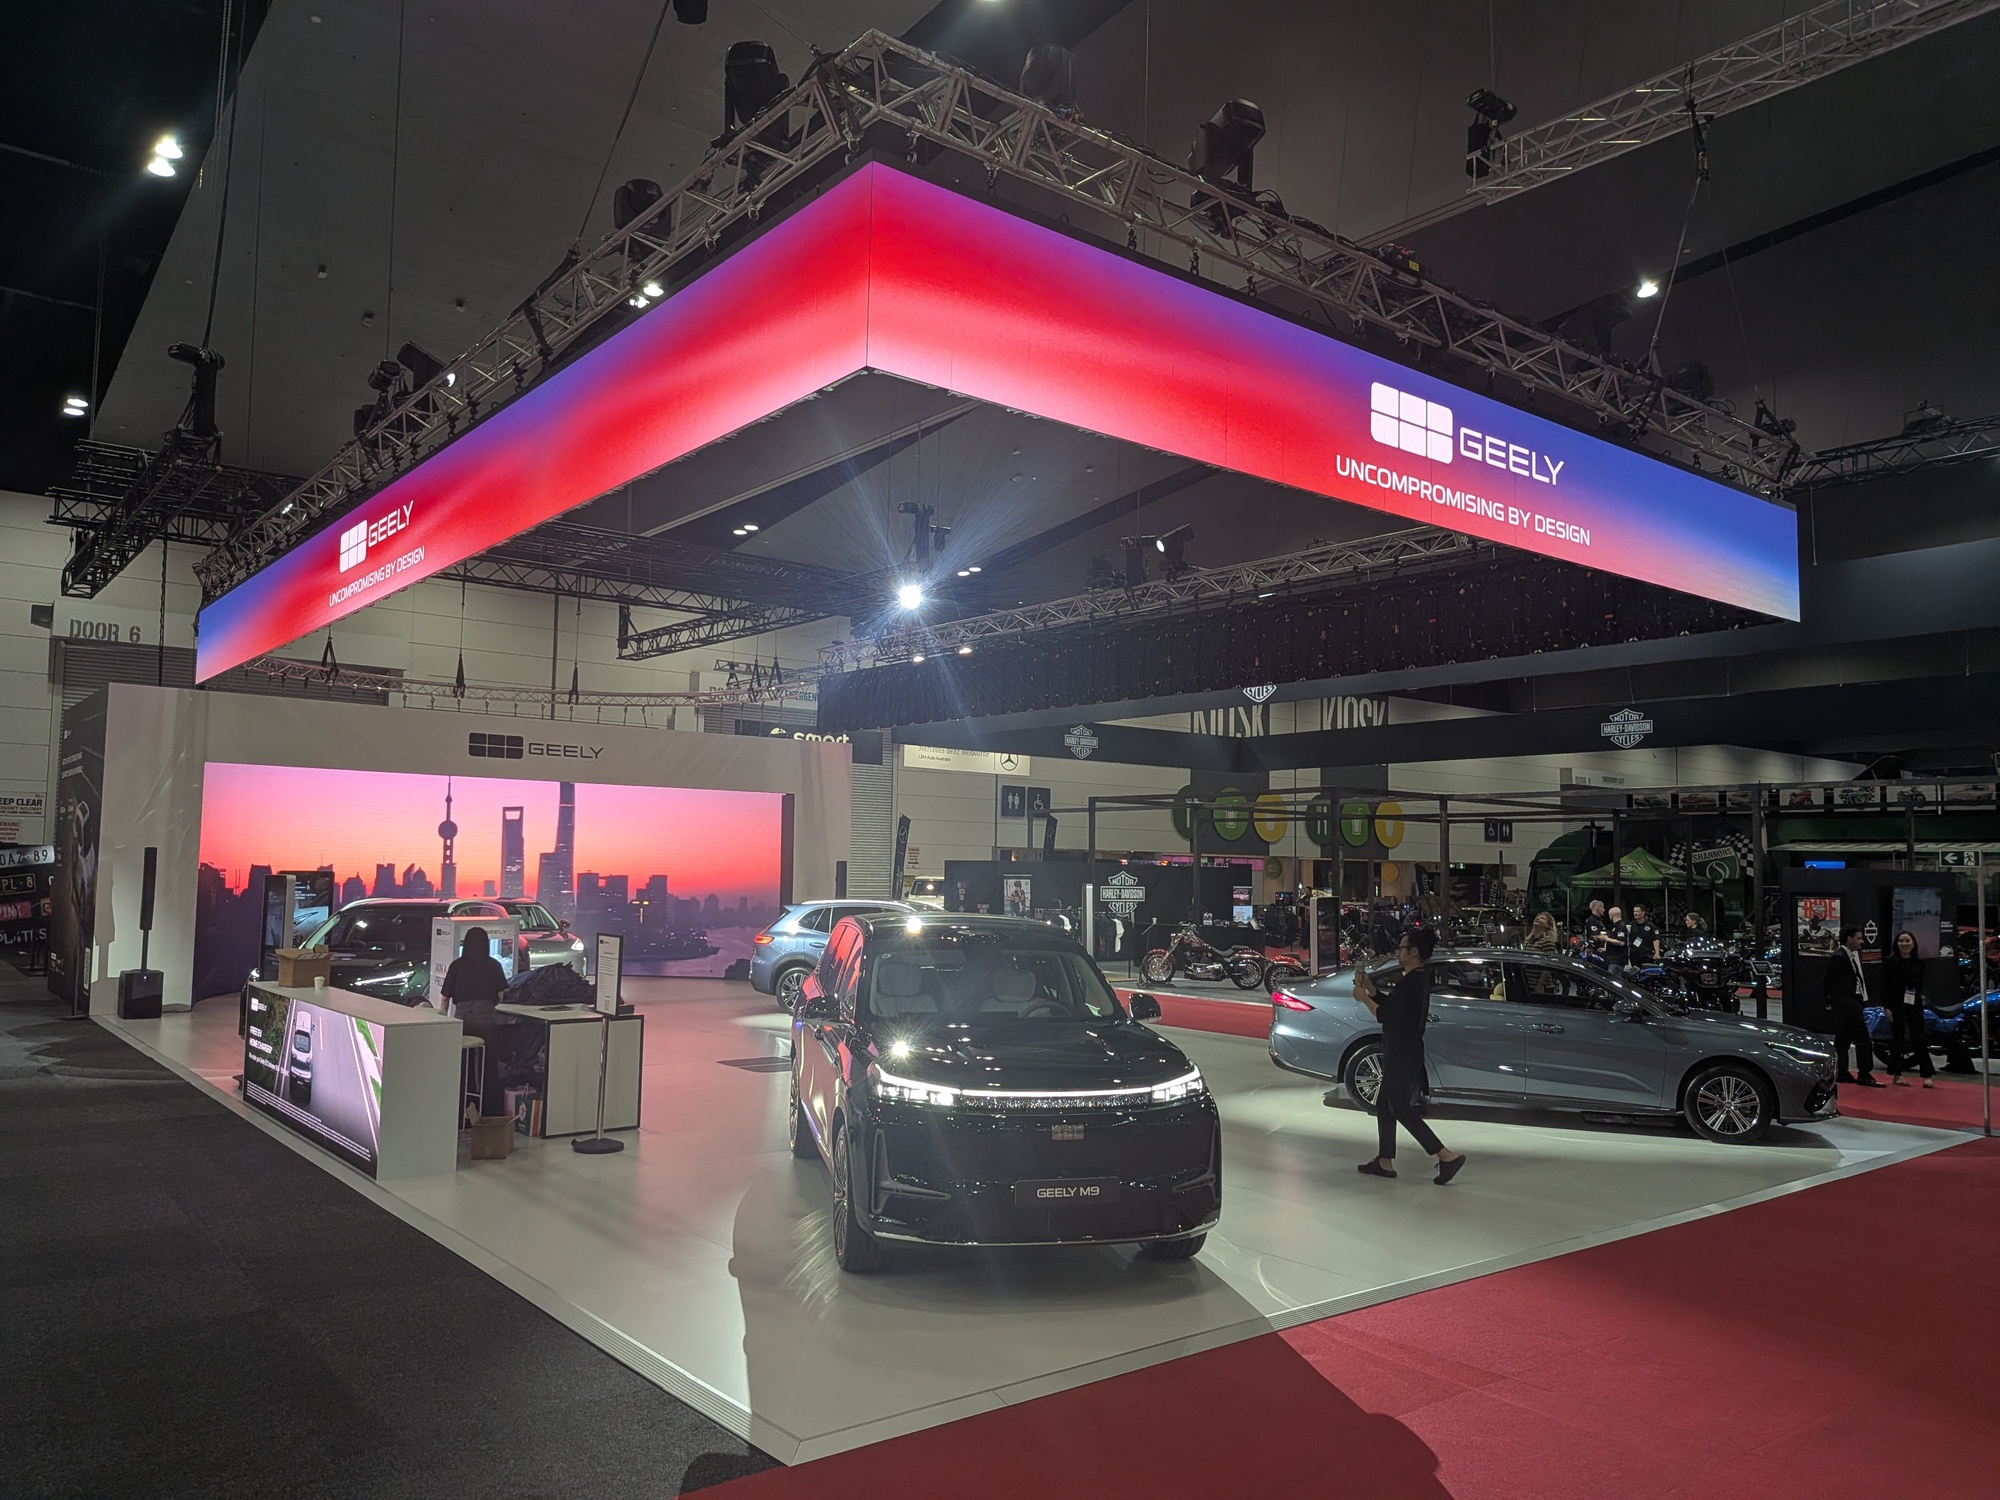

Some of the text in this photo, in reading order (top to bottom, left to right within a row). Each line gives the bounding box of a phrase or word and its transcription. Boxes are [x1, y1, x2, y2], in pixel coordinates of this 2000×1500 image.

[1459, 426, 1565, 486] GEELY
[1335, 454, 1591, 547] UNCOMPROMISING BY DESIGN
[367, 500, 414, 548] GEELY
[329, 545, 425, 607] UNCOMPROMISING BY DESIGN
[69, 618, 141, 643] DOOR 6
[1246, 684, 1273, 700] CYCLES
[1613, 711, 1640, 722] MOTOR
[1603, 722, 1651, 734] HARLEY-DAVIDSON
[1614, 734, 1640, 746] CYCLES
[528, 742, 604, 759] GEELY
[16, 798, 43, 807] CLEAR
[1692, 848, 1733, 862] SHANNONS
[1111, 873, 1135, 886] MOTOR
[1111, 901, 1135, 914] CYCLES
[1036, 1186, 1100, 1198] GEELY M9
